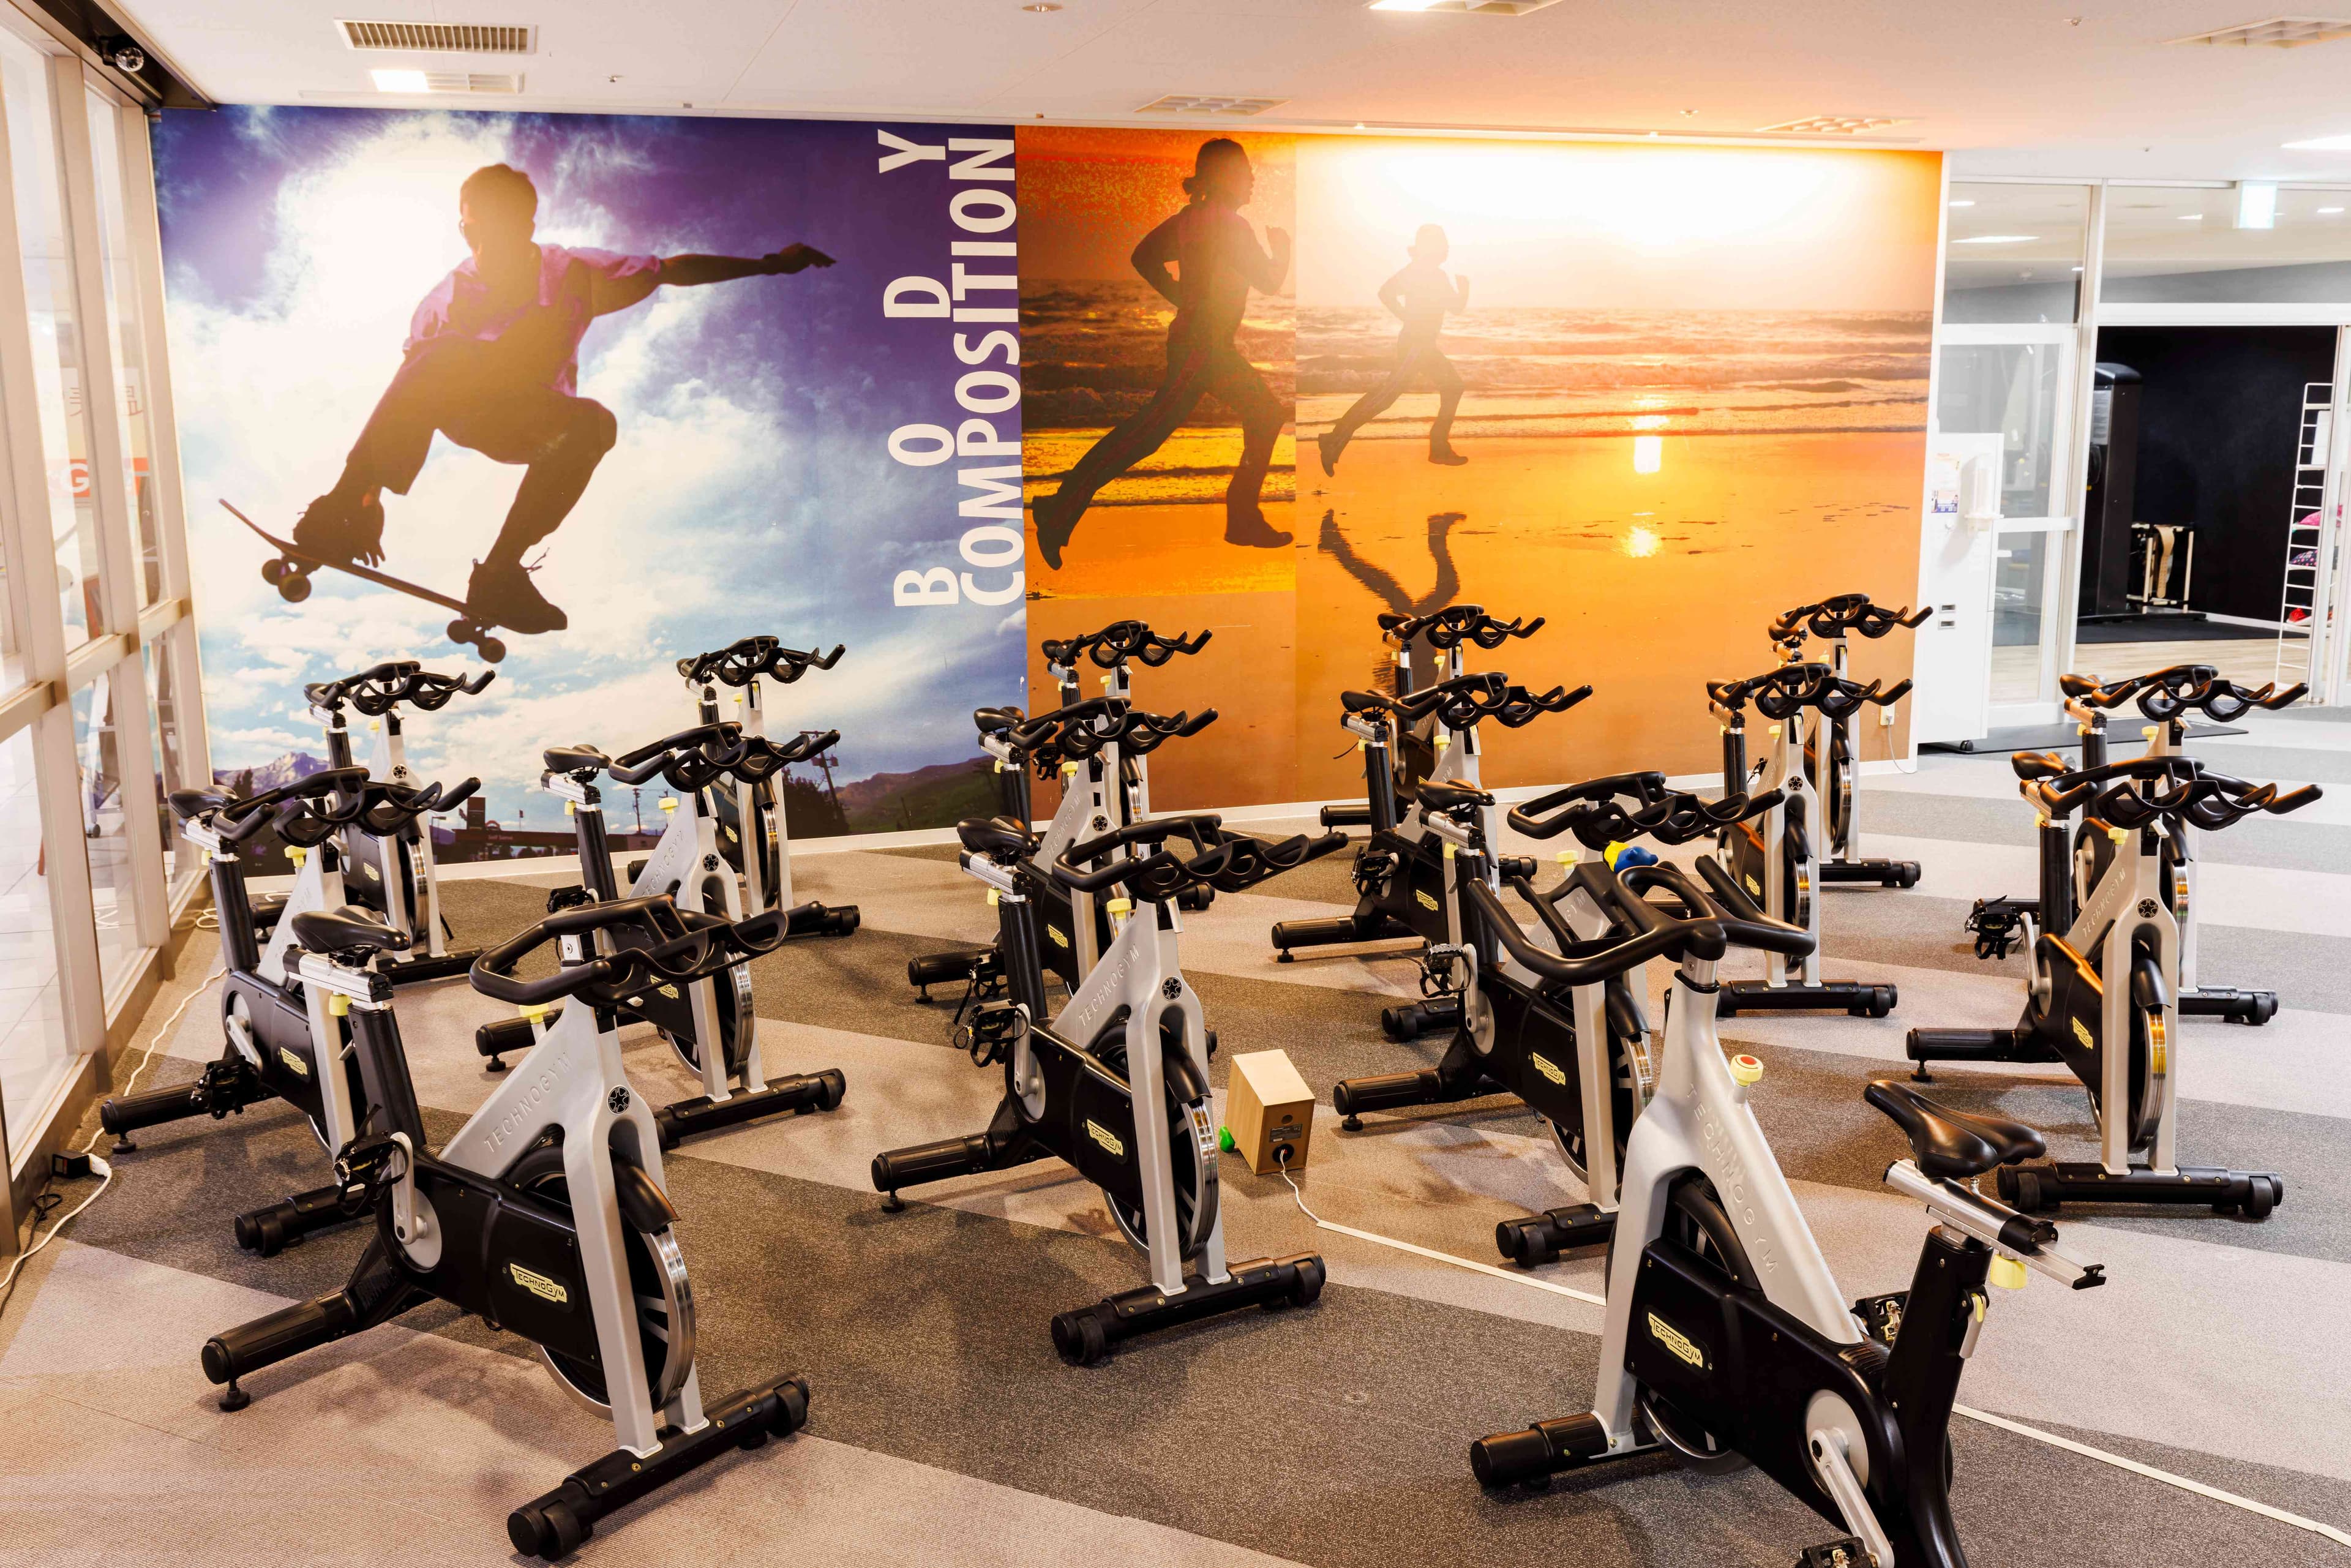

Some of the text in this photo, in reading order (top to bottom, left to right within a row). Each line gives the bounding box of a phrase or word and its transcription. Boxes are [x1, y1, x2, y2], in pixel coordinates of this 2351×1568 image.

[948, 138, 1026, 606] COMPOSITION
[1078, 943, 1139, 1027] TECHNOGYM
[1534, 1055, 1564, 1081] TECHNOGYM
[483, 1052, 574, 1153] TECHNOGYM
[1088, 1122, 1122, 1151] TECHNOGYM
[1687, 1082, 1778, 1273] TECHNOGYM
[512, 1266, 564, 1298] TECHNOGYM
[1650, 1316, 1700, 1362] TECHNOGYM
